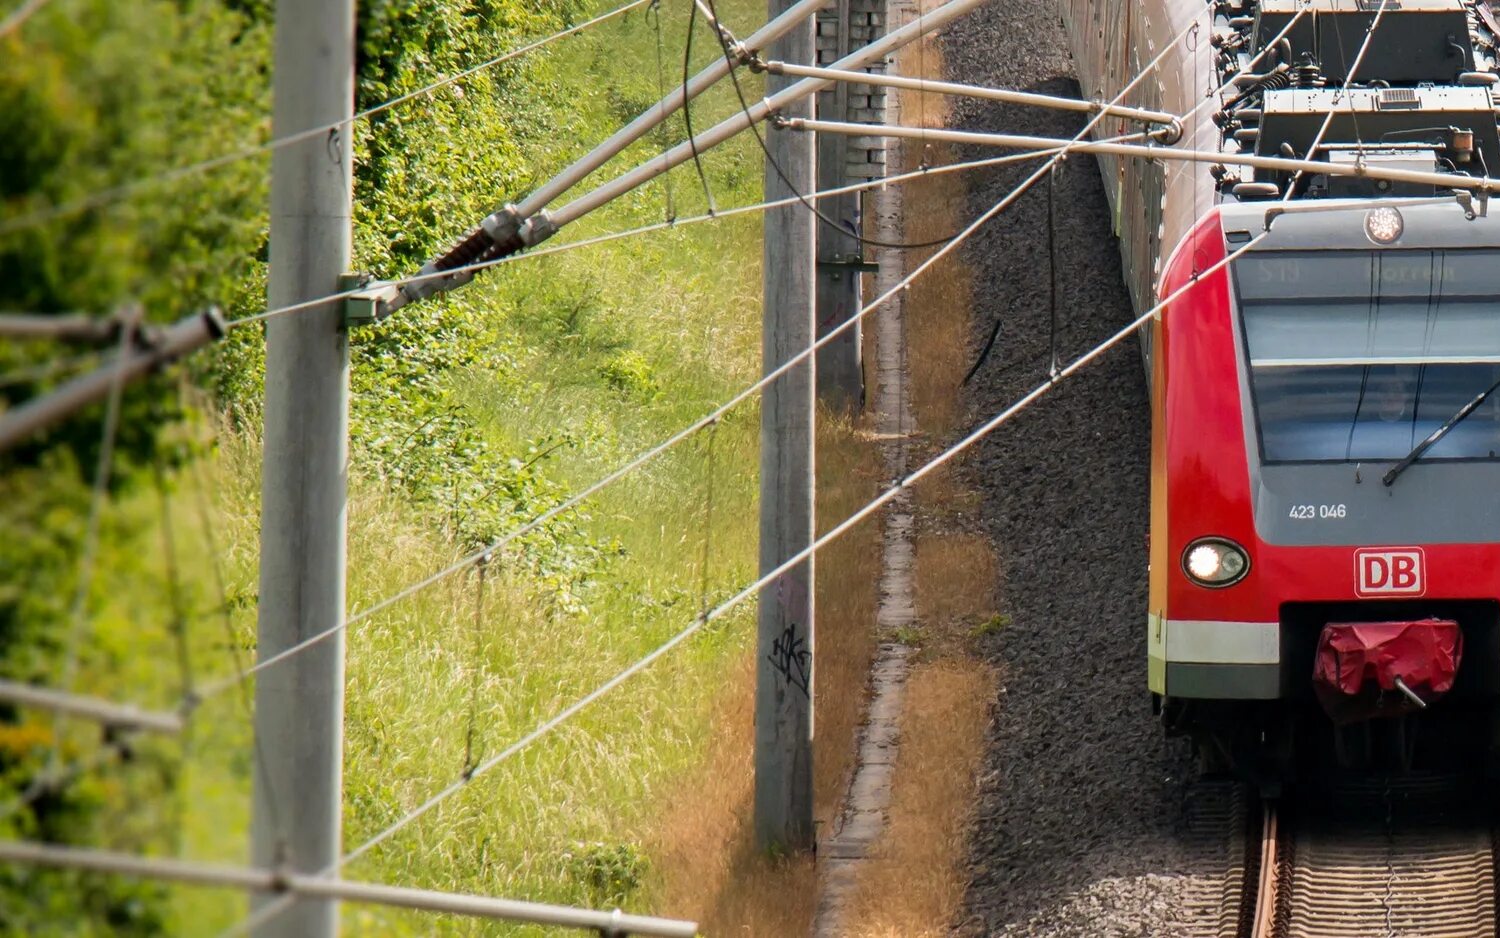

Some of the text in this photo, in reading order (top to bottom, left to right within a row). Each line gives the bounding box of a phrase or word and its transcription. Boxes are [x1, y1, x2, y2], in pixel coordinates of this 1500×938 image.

[1288, 503, 1347, 519] 423 046
[1363, 555, 1418, 589] DB
